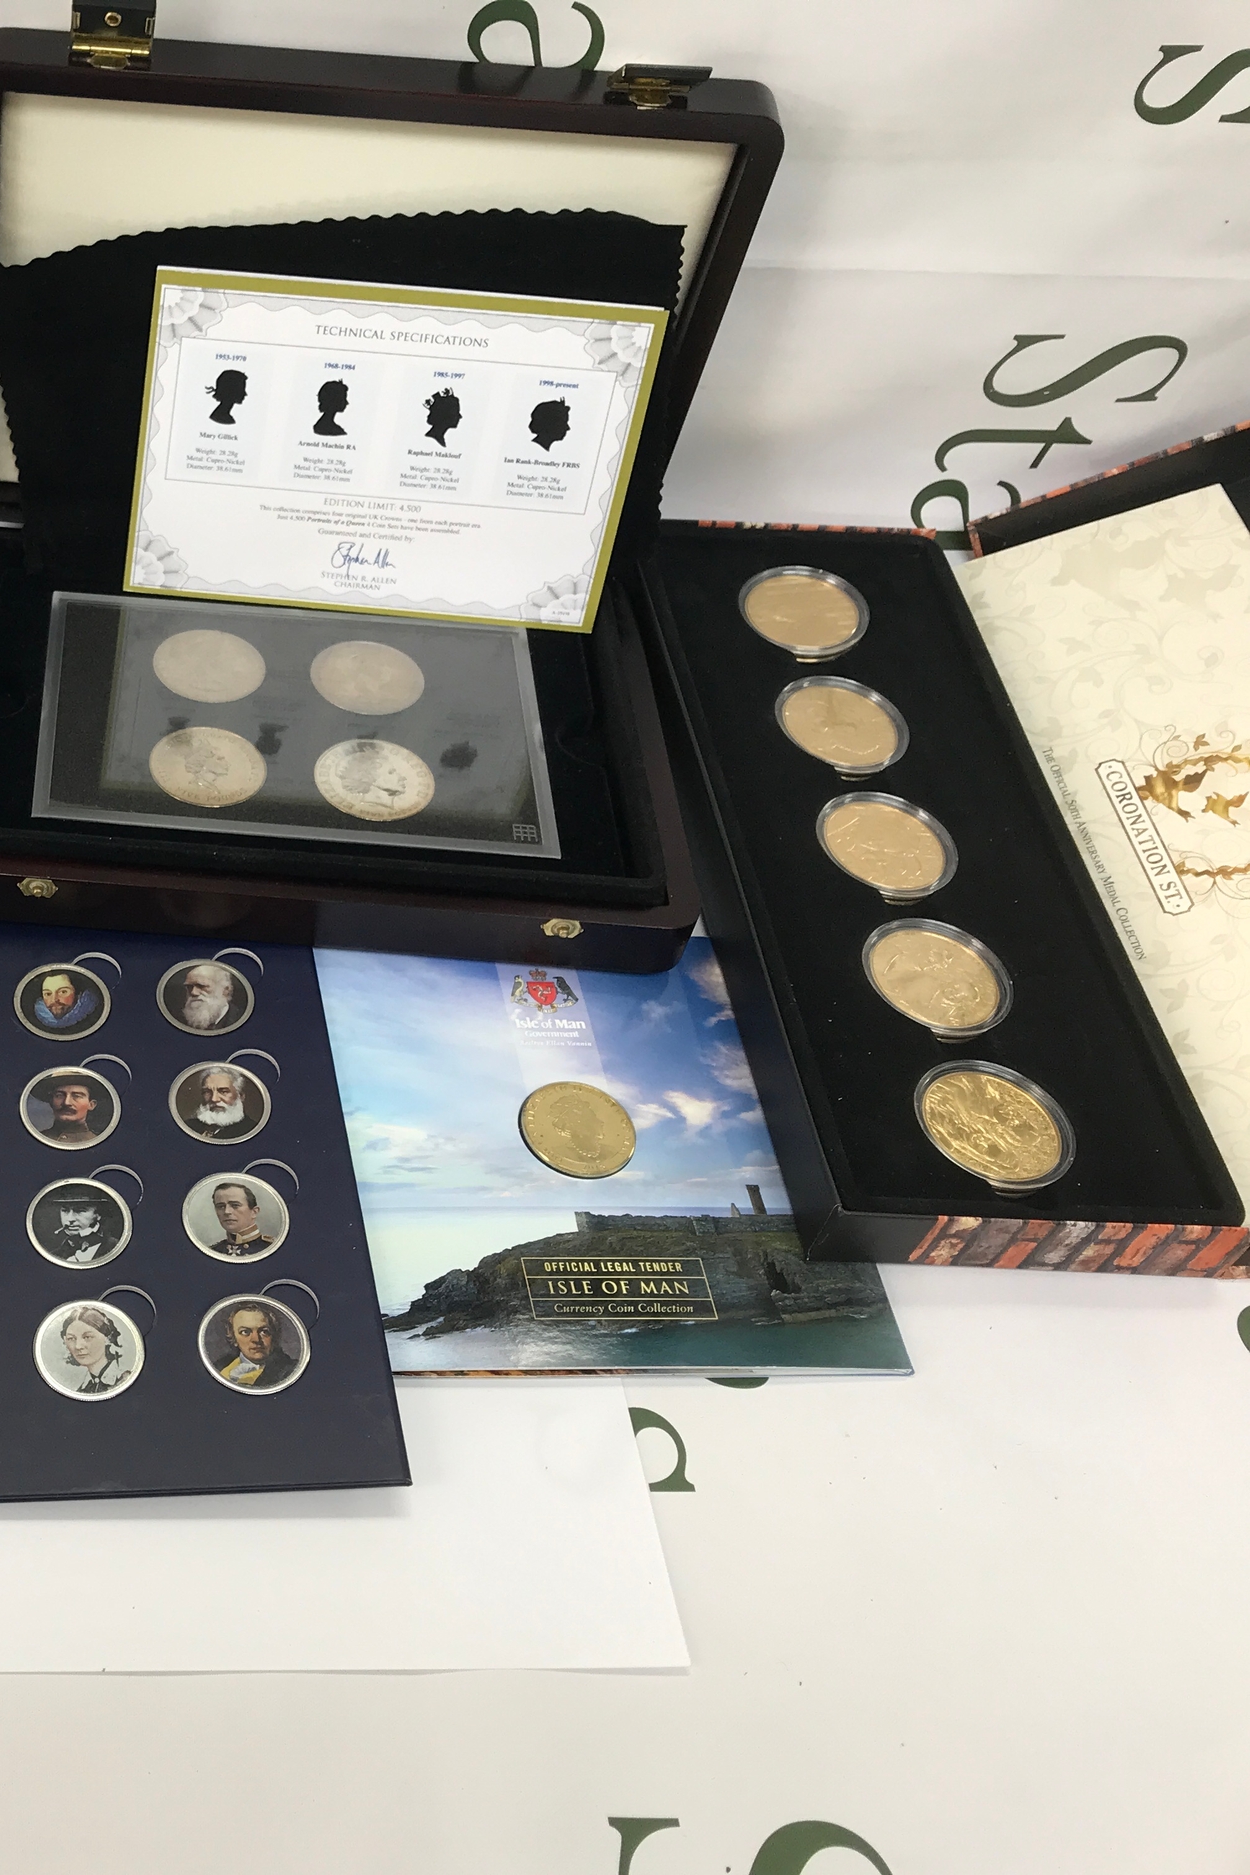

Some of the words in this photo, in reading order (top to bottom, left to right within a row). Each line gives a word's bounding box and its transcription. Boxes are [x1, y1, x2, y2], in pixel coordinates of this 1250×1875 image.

[315, 325, 386, 340] TECHNICAL
[390, 330, 490, 348] SPECIFICATIONS
[215, 353, 247, 362] 1953-1970
[324, 362, 356, 371] 1968-1984
[433, 371, 465, 380] 1985-1997
[539, 379, 579, 390] 1998-present
[199, 431, 216, 440] Mary
[298, 440, 320, 448] Arnold
[407, 449, 433, 457] Raphael
[515, 458, 560, 468] Rank-Broadley
[323, 497, 366, 509] EDITION
[367, 501, 396, 511] LIMIT:
[318, 527, 357, 538] Guaranteed
[358, 530, 371, 539] and
[373, 532, 403, 542] Certified
[321, 571, 359, 581] STEPHEN
[370, 576, 397, 584] ALLEN
[334, 580, 381, 591] CHAIRMAN
[1105, 769, 1171, 879] CORONATION
[1041, 746, 1054, 764] THE
[1050, 763, 1070, 798] OFFICIAL
[1076, 820, 1107, 876] ANNIVERSARY
[1101, 874, 1120, 908] MEDAL
[1116, 906, 1148, 961] COLLECTION
[514, 1016, 539, 1029] Isle
[540, 1018, 553, 1029] of
[555, 1018, 587, 1030] Man
[524, 1030, 580, 1038] Government
[543, 1261, 598, 1273] OFFICIAL
[601, 1261, 636, 1273] LEGAL
[638, 1261, 683, 1273] TENDER
[547, 1280, 594, 1295] ISLE
[601, 1280, 630, 1295] OF
[640, 1280, 690, 1295] MAN
[553, 1302, 605, 1315] Currency
[608, 1302, 635, 1313] Coin
[638, 1302, 694, 1313] Collection
